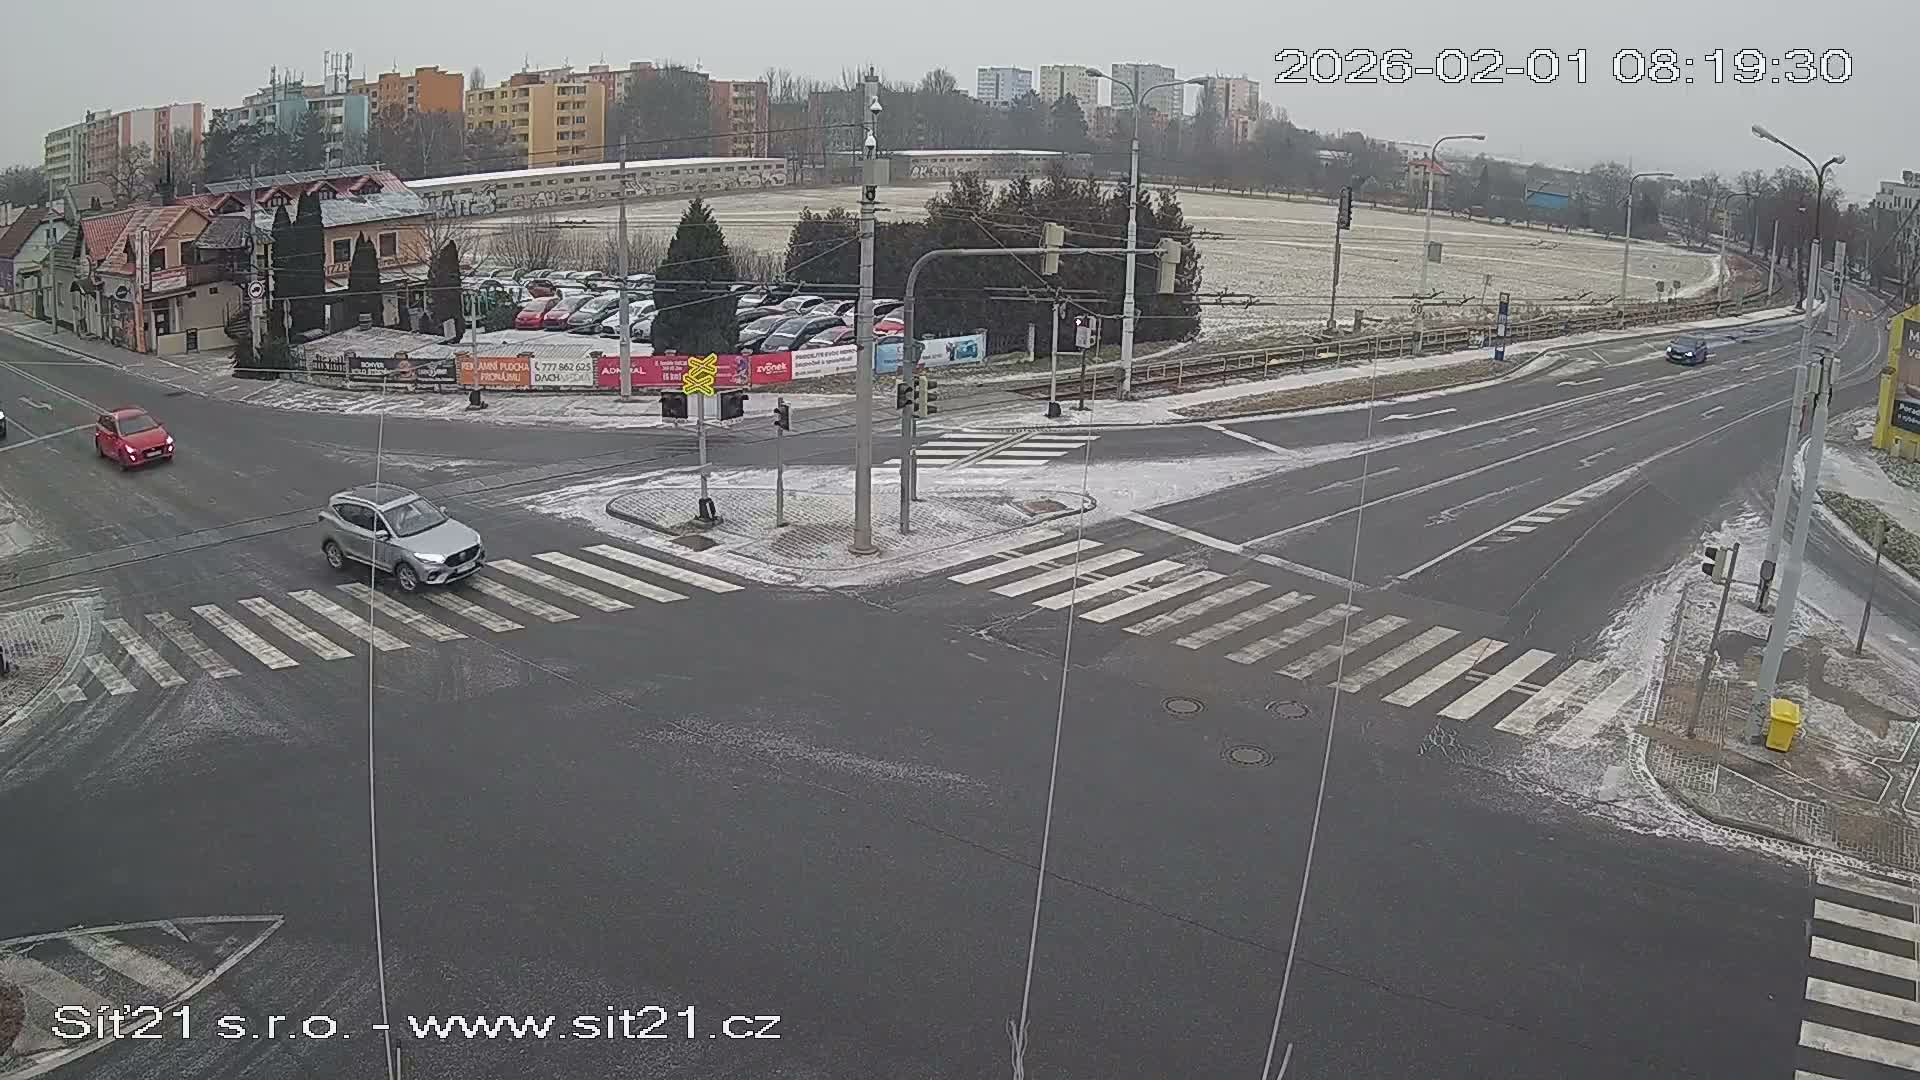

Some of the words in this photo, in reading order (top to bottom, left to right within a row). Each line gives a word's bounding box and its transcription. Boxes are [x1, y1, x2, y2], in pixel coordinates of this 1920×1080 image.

[542, 363, 557, 372] 777
[558, 363, 574, 372] 862
[575, 363, 591, 372] 625
